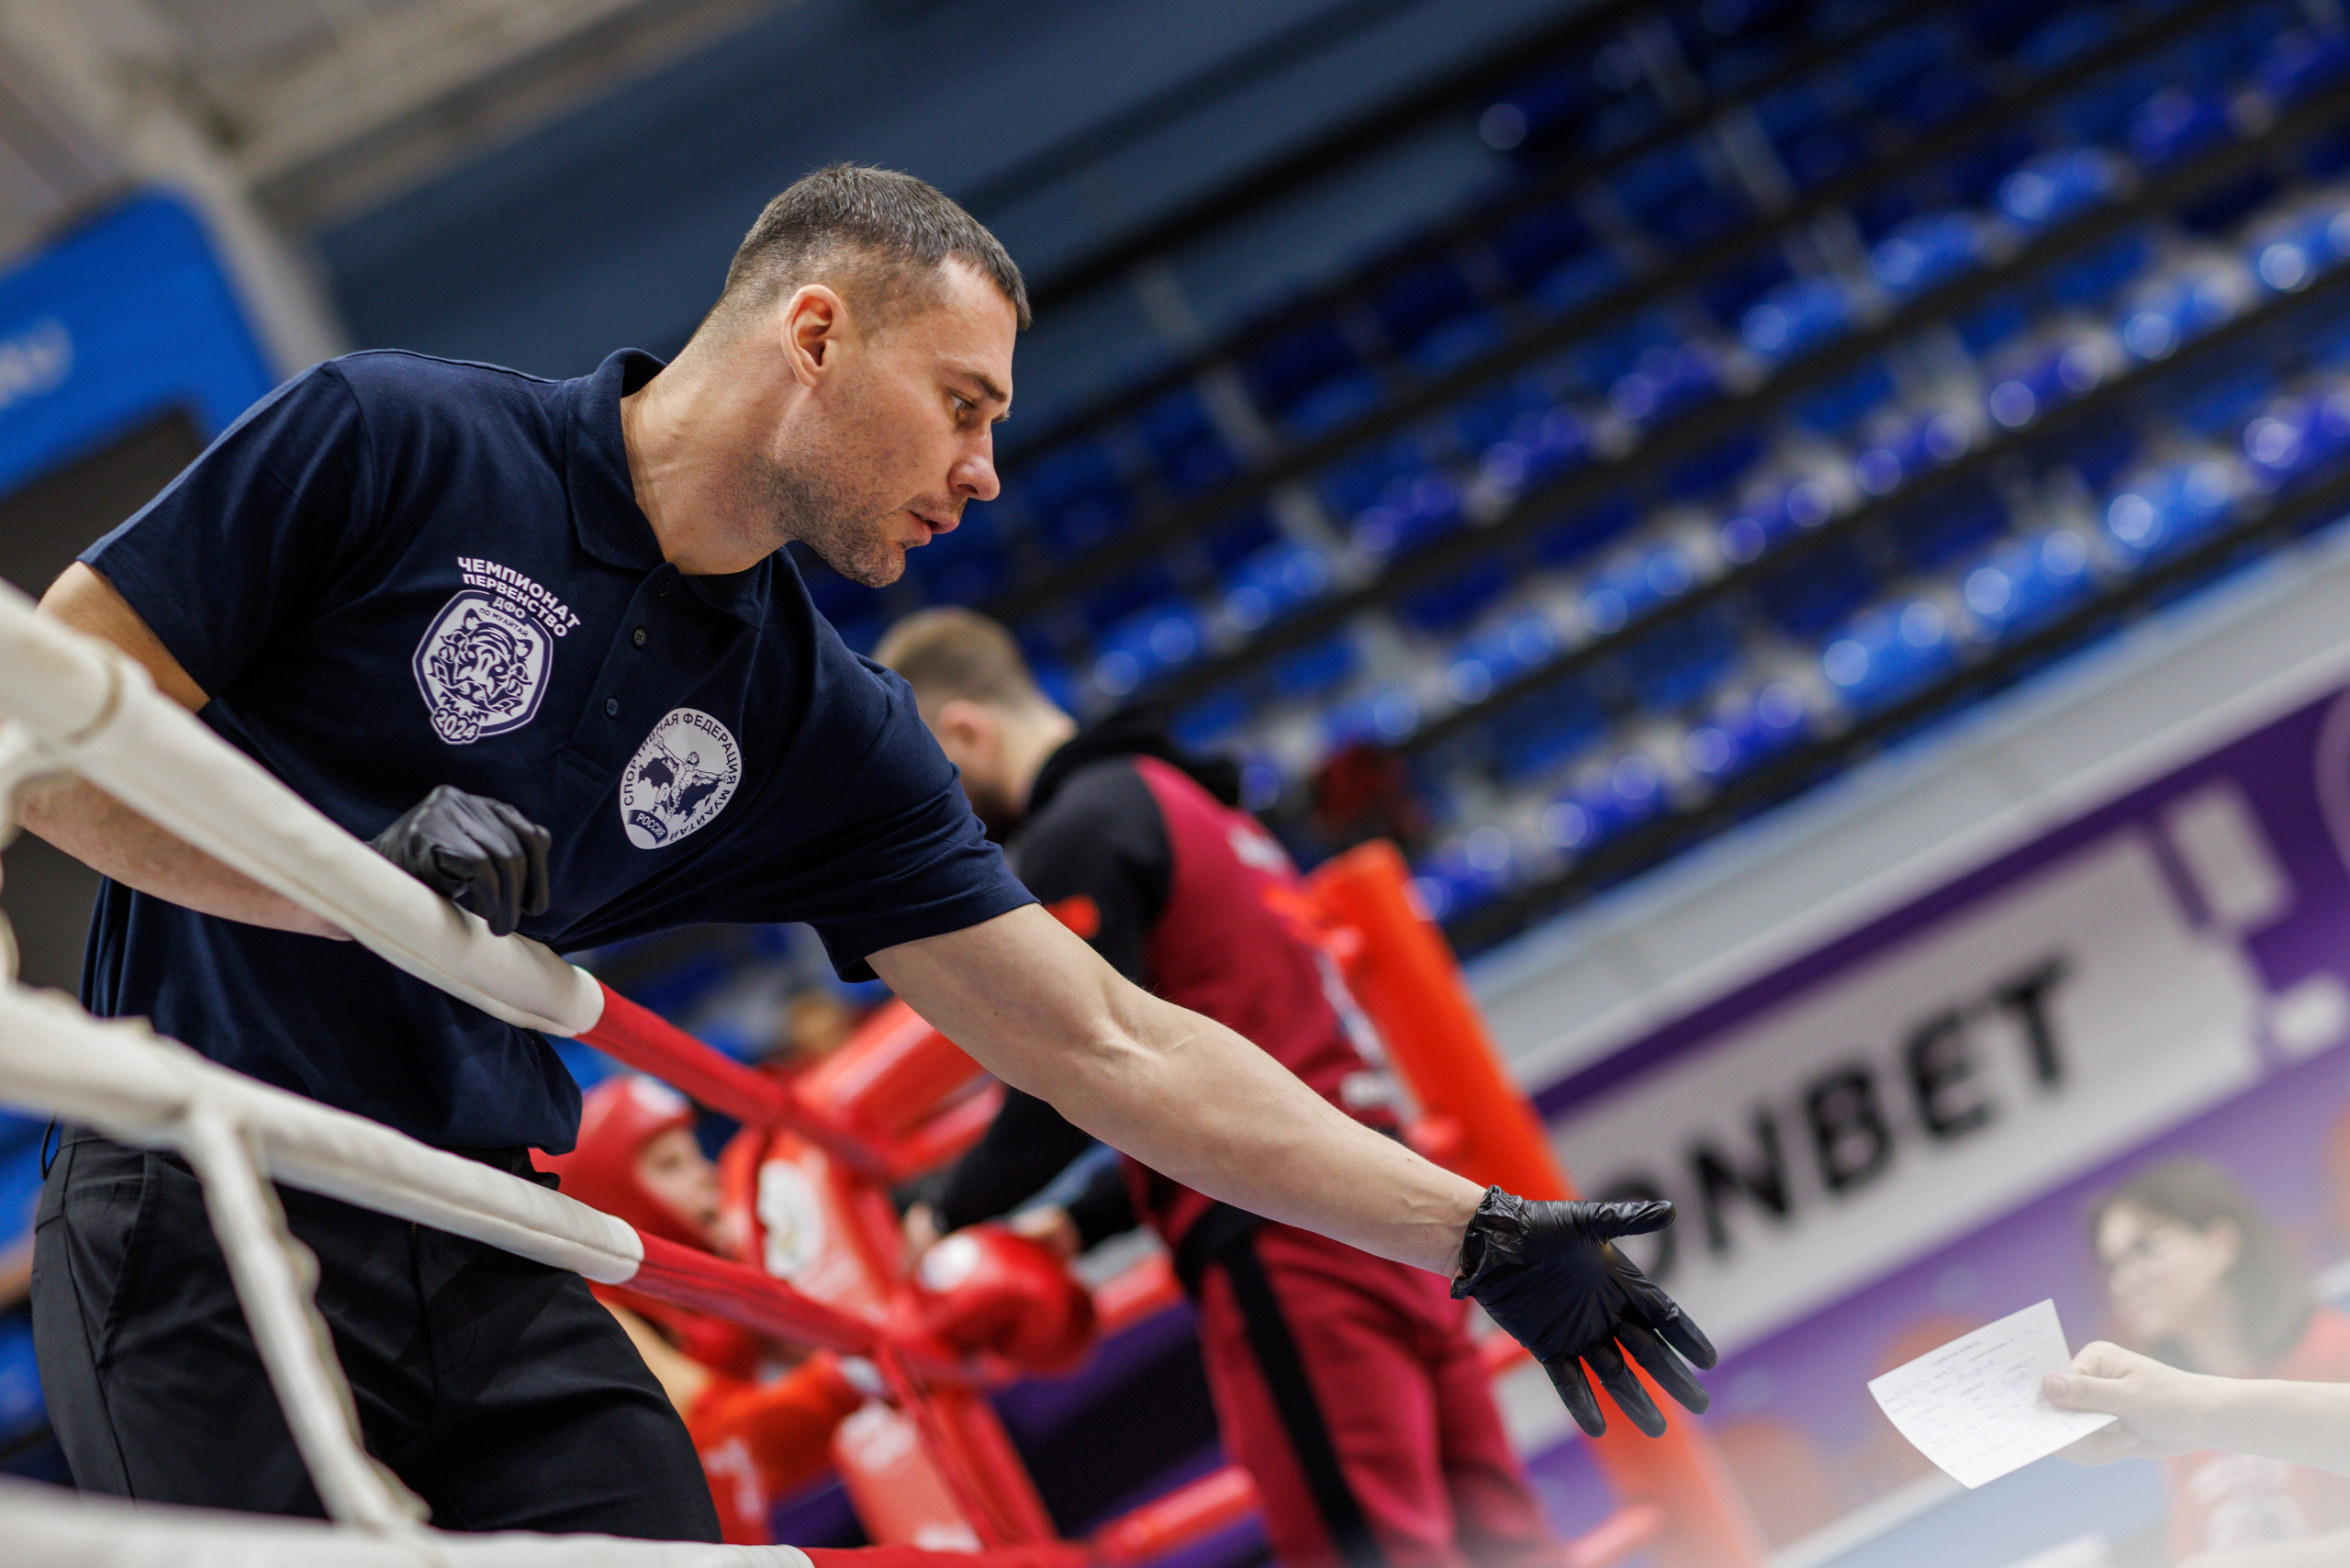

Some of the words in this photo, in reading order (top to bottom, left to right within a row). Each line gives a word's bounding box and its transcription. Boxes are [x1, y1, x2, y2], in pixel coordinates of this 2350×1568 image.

[457, 556, 581, 628] ЧЕМПИОНАТ
[463, 574, 567, 637] ПЕРВЕНСТВО
[492, 596, 526, 619] ДФО
[479, 607, 490, 616] ПО
[492, 612, 529, 637] МУАЙТАЙ
[435, 710, 477, 739] 2024
[683, 712, 738, 784] ФЕДЕРАЦИЯ
[624, 713, 679, 806] СПОРТИВНАЯ
[636, 812, 666, 839] РОССИЯ
[669, 790, 731, 842] МУАЙТАЙ
